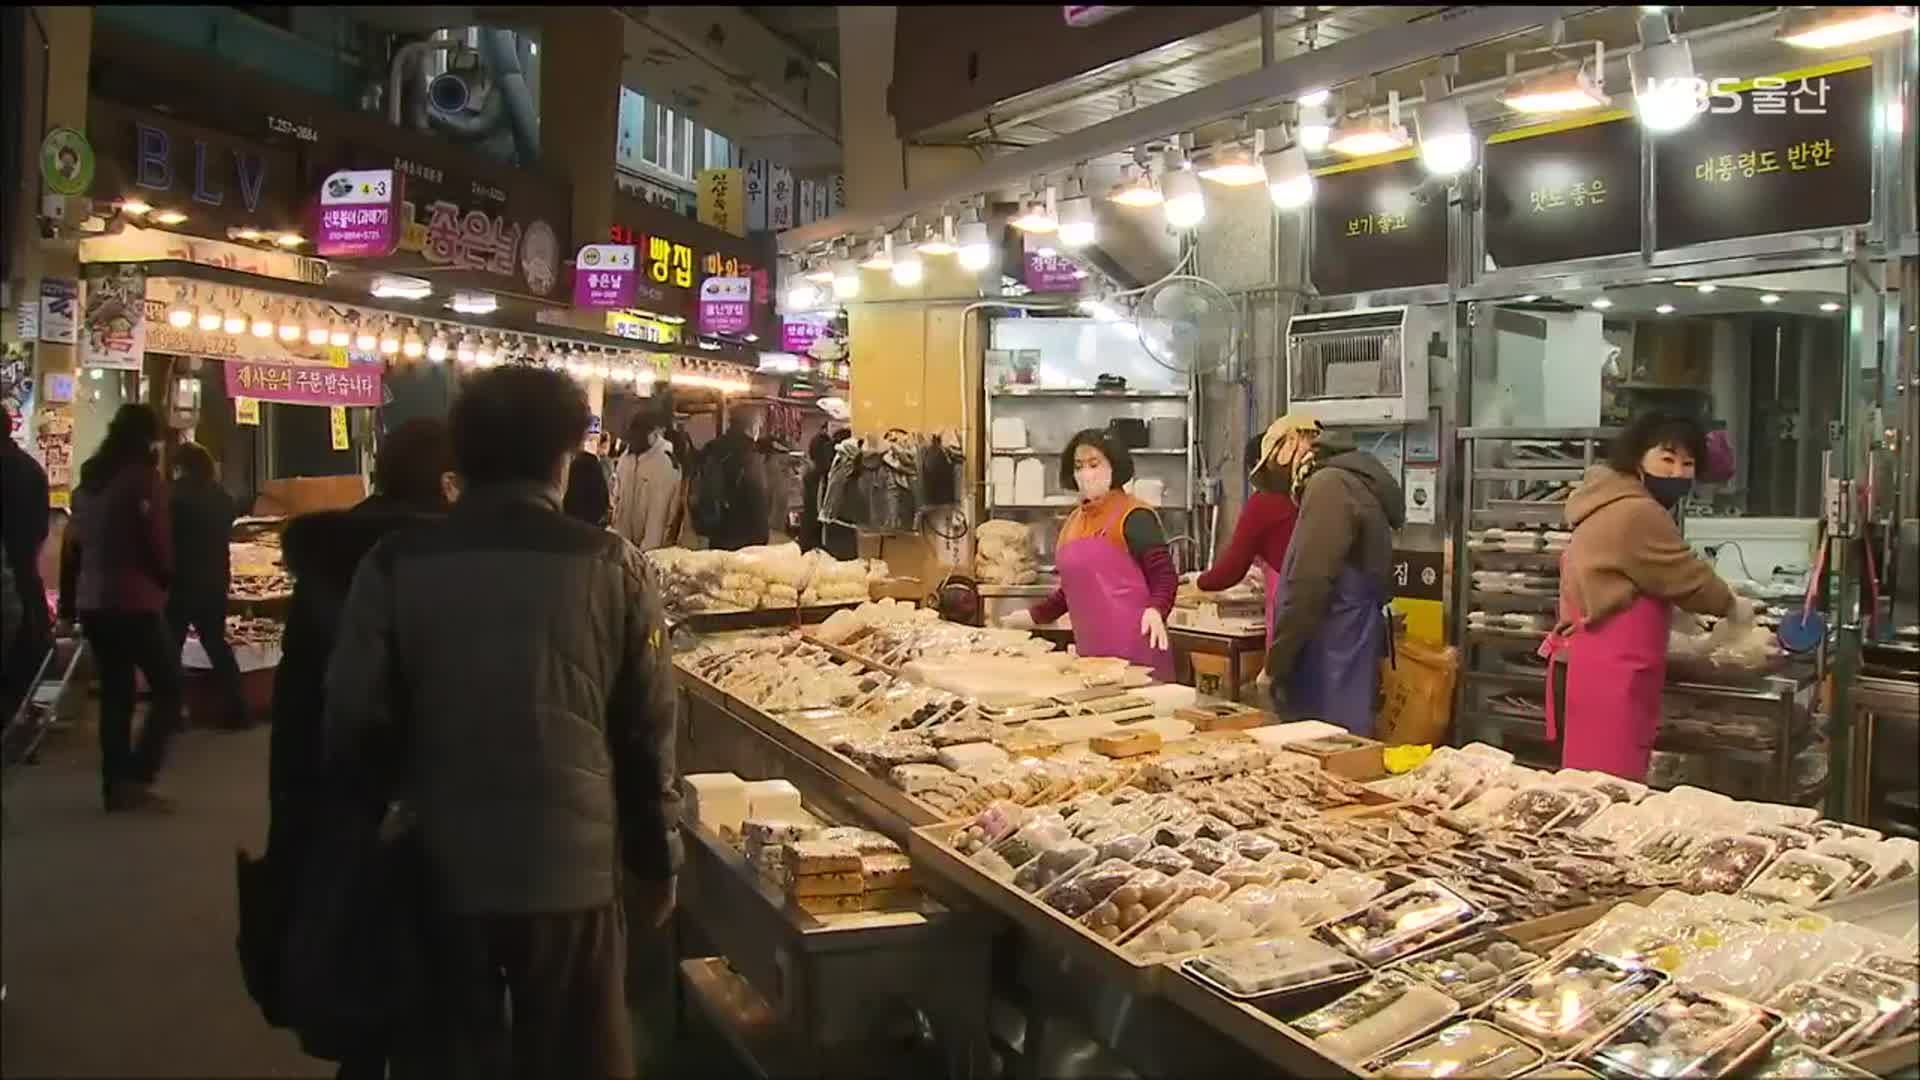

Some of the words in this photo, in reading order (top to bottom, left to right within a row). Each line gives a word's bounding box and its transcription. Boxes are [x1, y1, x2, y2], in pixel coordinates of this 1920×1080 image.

[1695, 151, 1780, 181] 대통령도
[1788, 139, 1834, 170] 반한
[1529, 188, 1566, 213] 맛도
[1570, 179, 1606, 207] 좋은
[1345, 214, 1373, 238] 보기
[650, 235, 692, 289] 빵집
[1031, 256, 1077, 272] 정일수
[237, 363, 293, 391] 제사음식
[296, 369, 324, 395] 주문
[325, 374, 373, 398] 받습니다
[1393, 561, 1409, 586] 집
